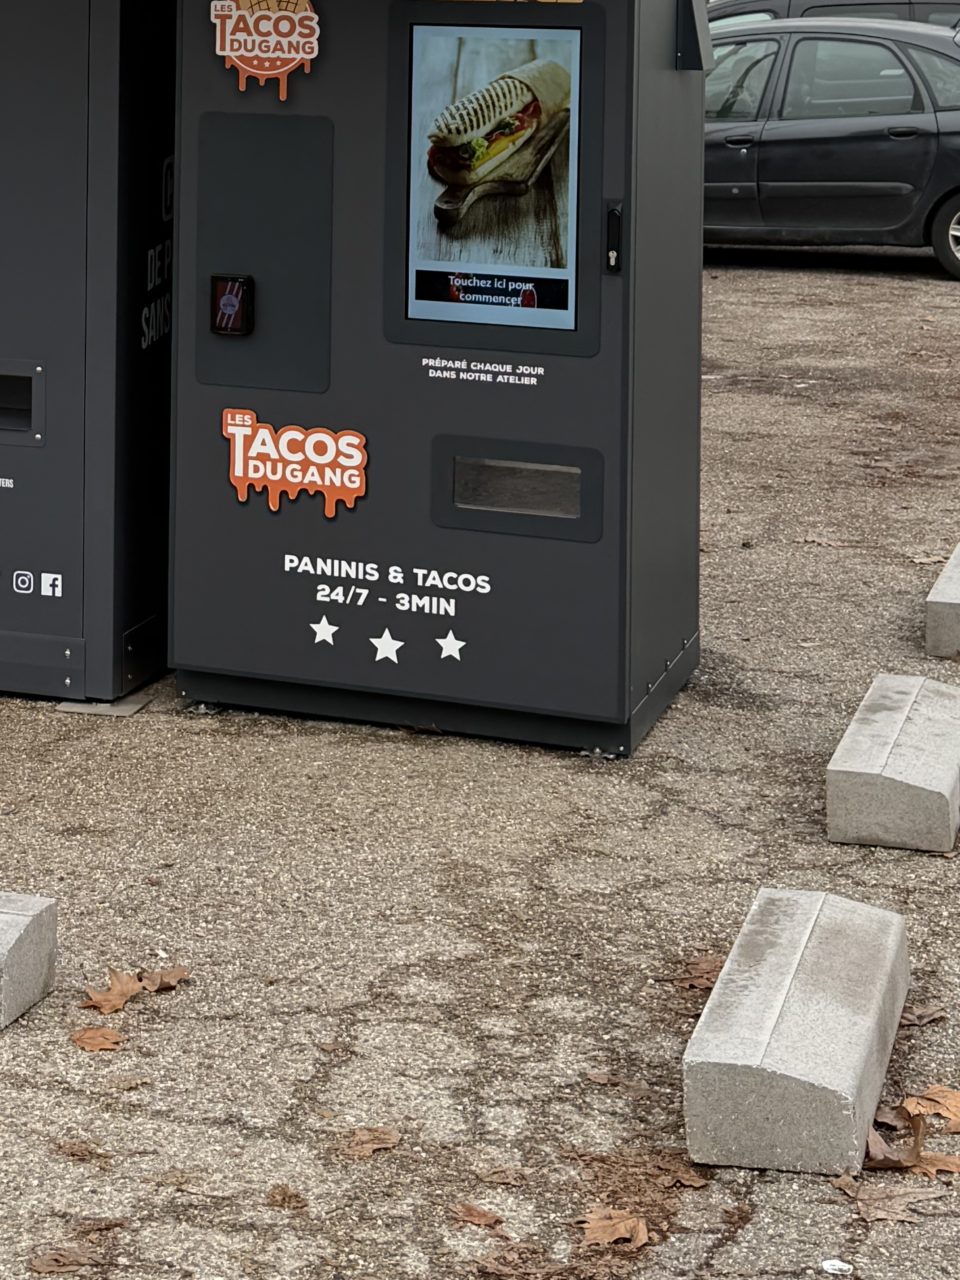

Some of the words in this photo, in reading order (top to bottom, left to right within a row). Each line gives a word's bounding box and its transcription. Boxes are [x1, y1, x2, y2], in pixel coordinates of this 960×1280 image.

[214, 4, 233, 13] LES
[214, 14, 316, 52] TACOS
[448, 275, 492, 288] Touchez
[494, 278, 506, 289] ici
[508, 281, 535, 292] pour
[459, 293, 522, 305] commencer
[422, 357, 468, 369] PRÉPARÉ
[470, 361, 513, 373] CHAQUE
[515, 365, 545, 376] JOUR
[428, 368, 457, 379] DANS
[459, 371, 493, 382] NOTRE
[496, 375, 538, 386] ATELIER
[227, 413, 252, 426] LES
[227, 426, 362, 477] TACOS
[284, 554, 380, 581] PANINIS
[388, 565, 404, 584] &
[412, 568, 491, 594] TACOS
[316, 584, 369, 606] 24/7
[395, 593, 456, 616] 3MIN
